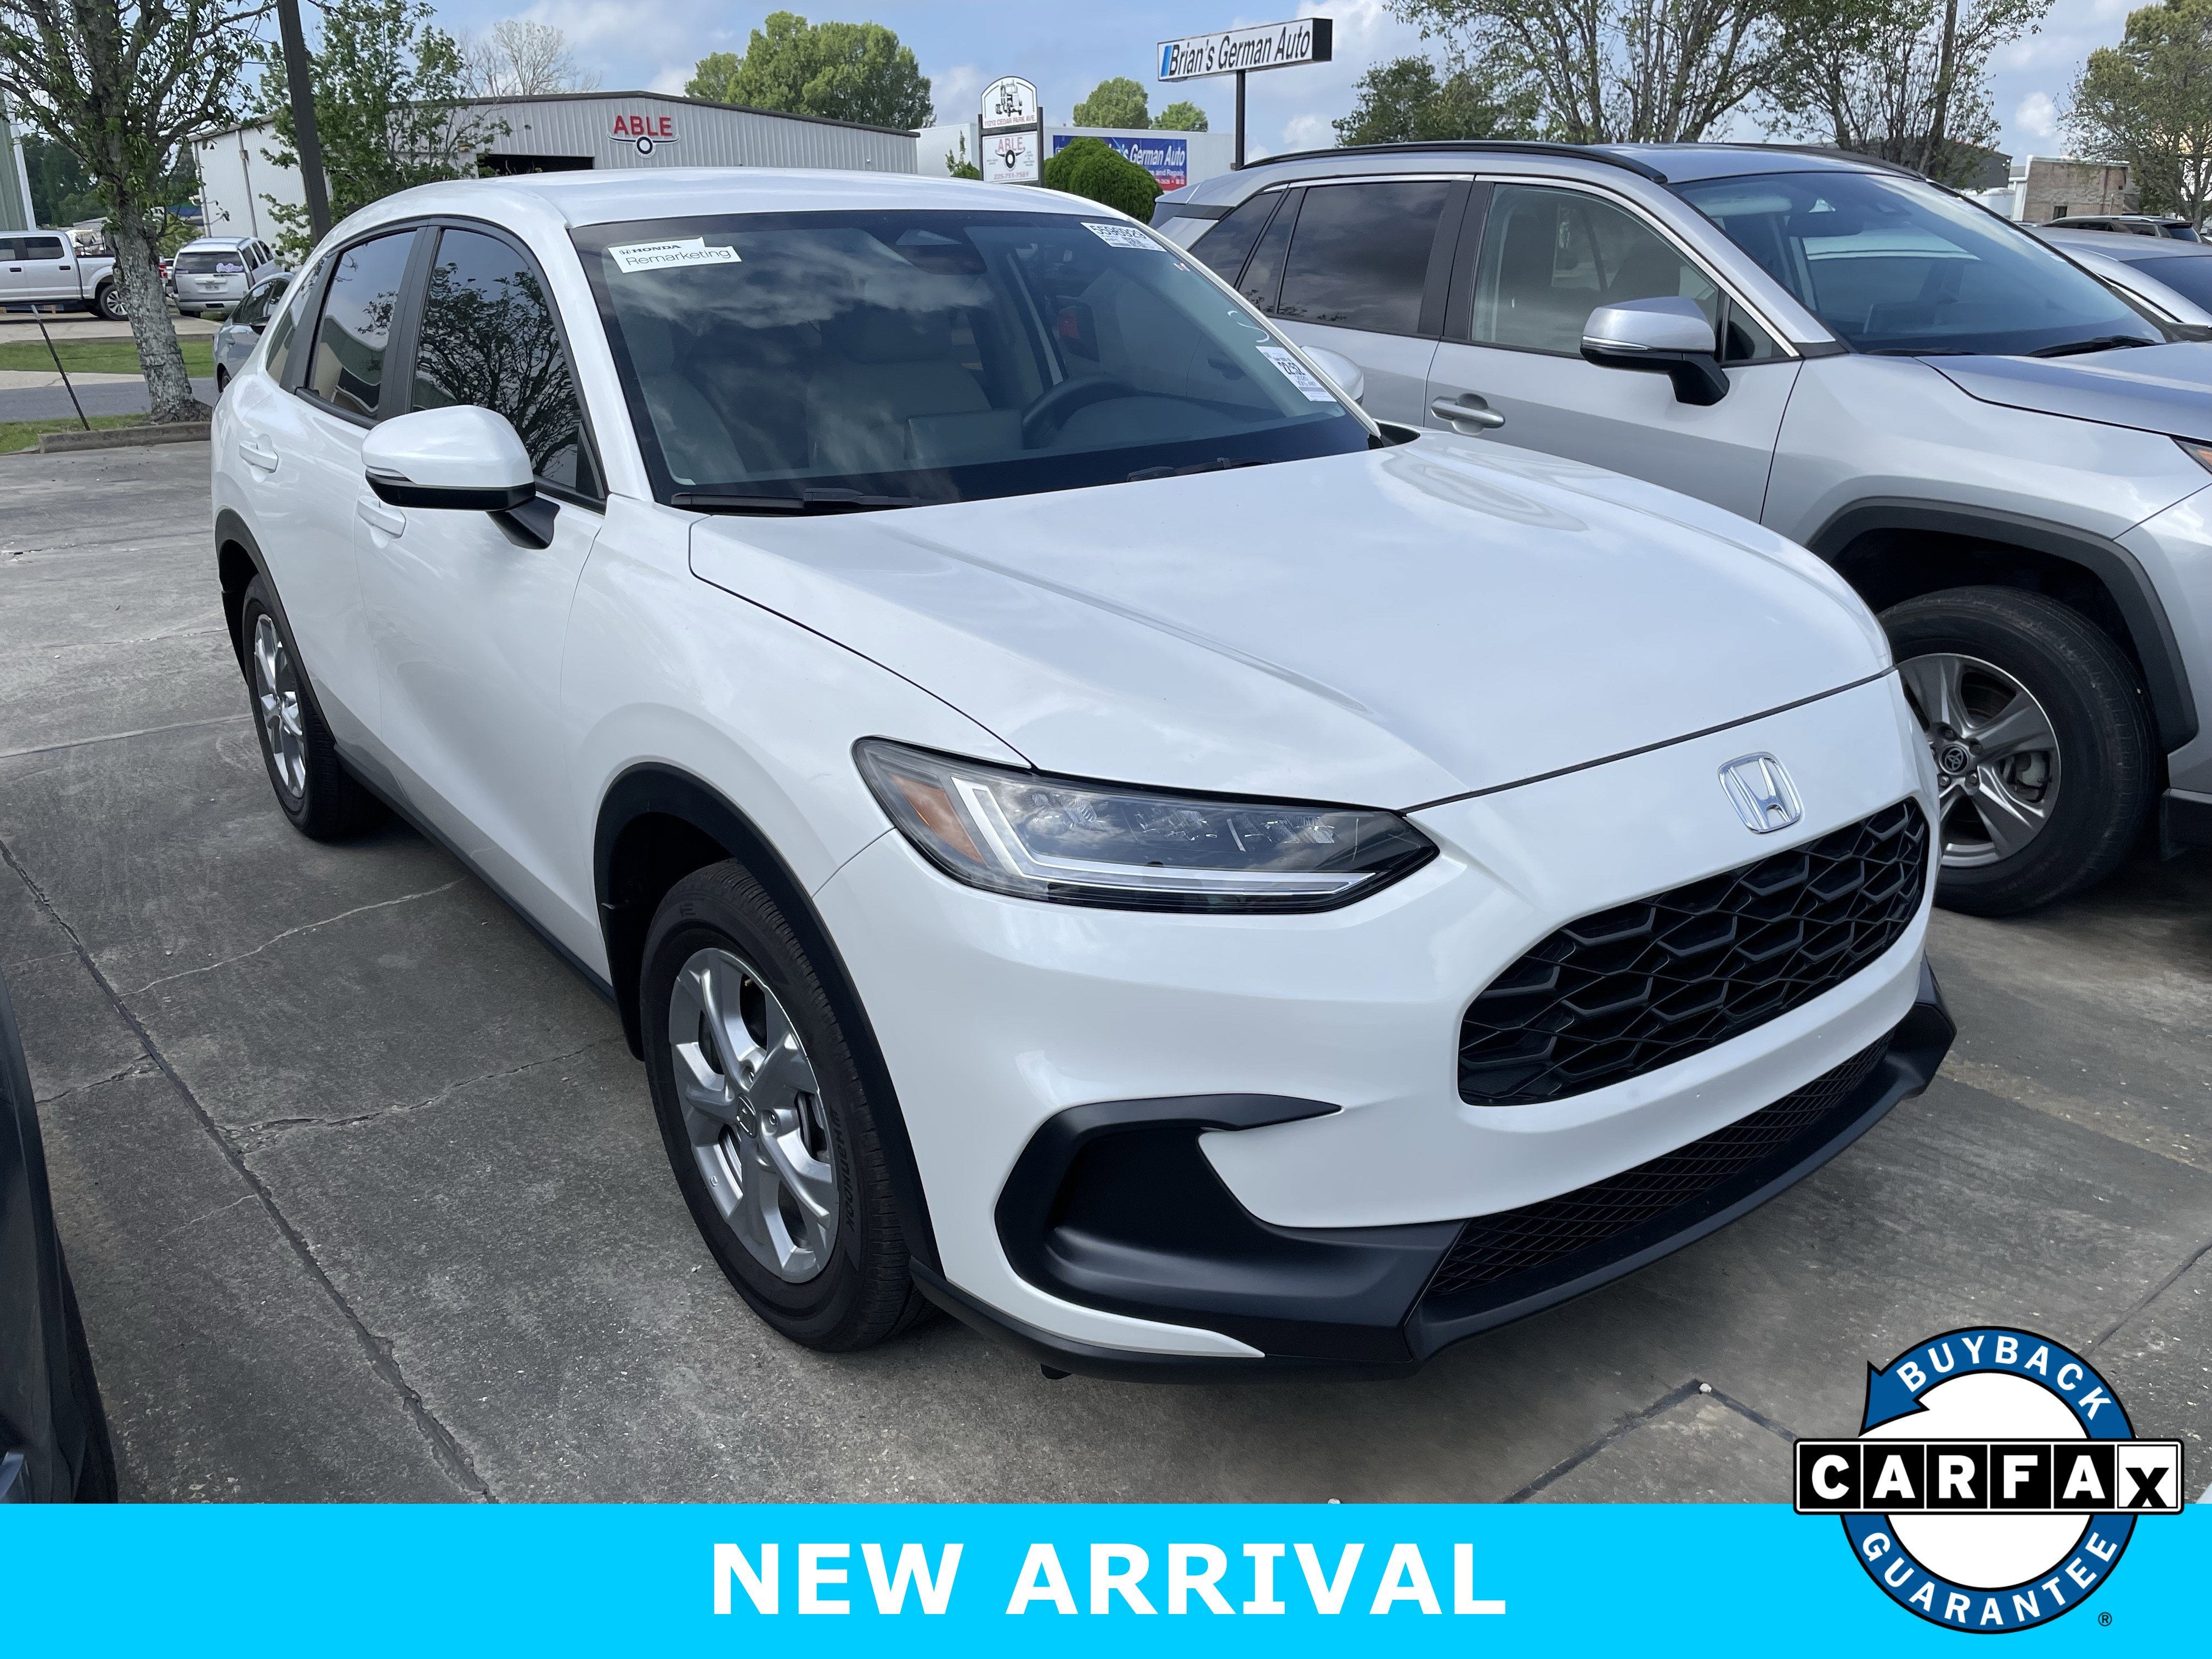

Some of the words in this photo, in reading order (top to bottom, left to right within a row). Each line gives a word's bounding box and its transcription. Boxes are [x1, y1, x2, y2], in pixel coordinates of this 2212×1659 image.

[1169, 39, 1215, 76] Brian's
[1218, 35, 1272, 70] German
[1274, 26, 1310, 61] Auto
[613, 115, 673, 136] ABLE
[997, 137, 1023, 152] ABLE
[1129, 144, 1164, 165] German
[1164, 145, 1186, 166] Auto
[625, 250, 731, 265] Remarketing
[633, 245, 681, 253] HONDA
